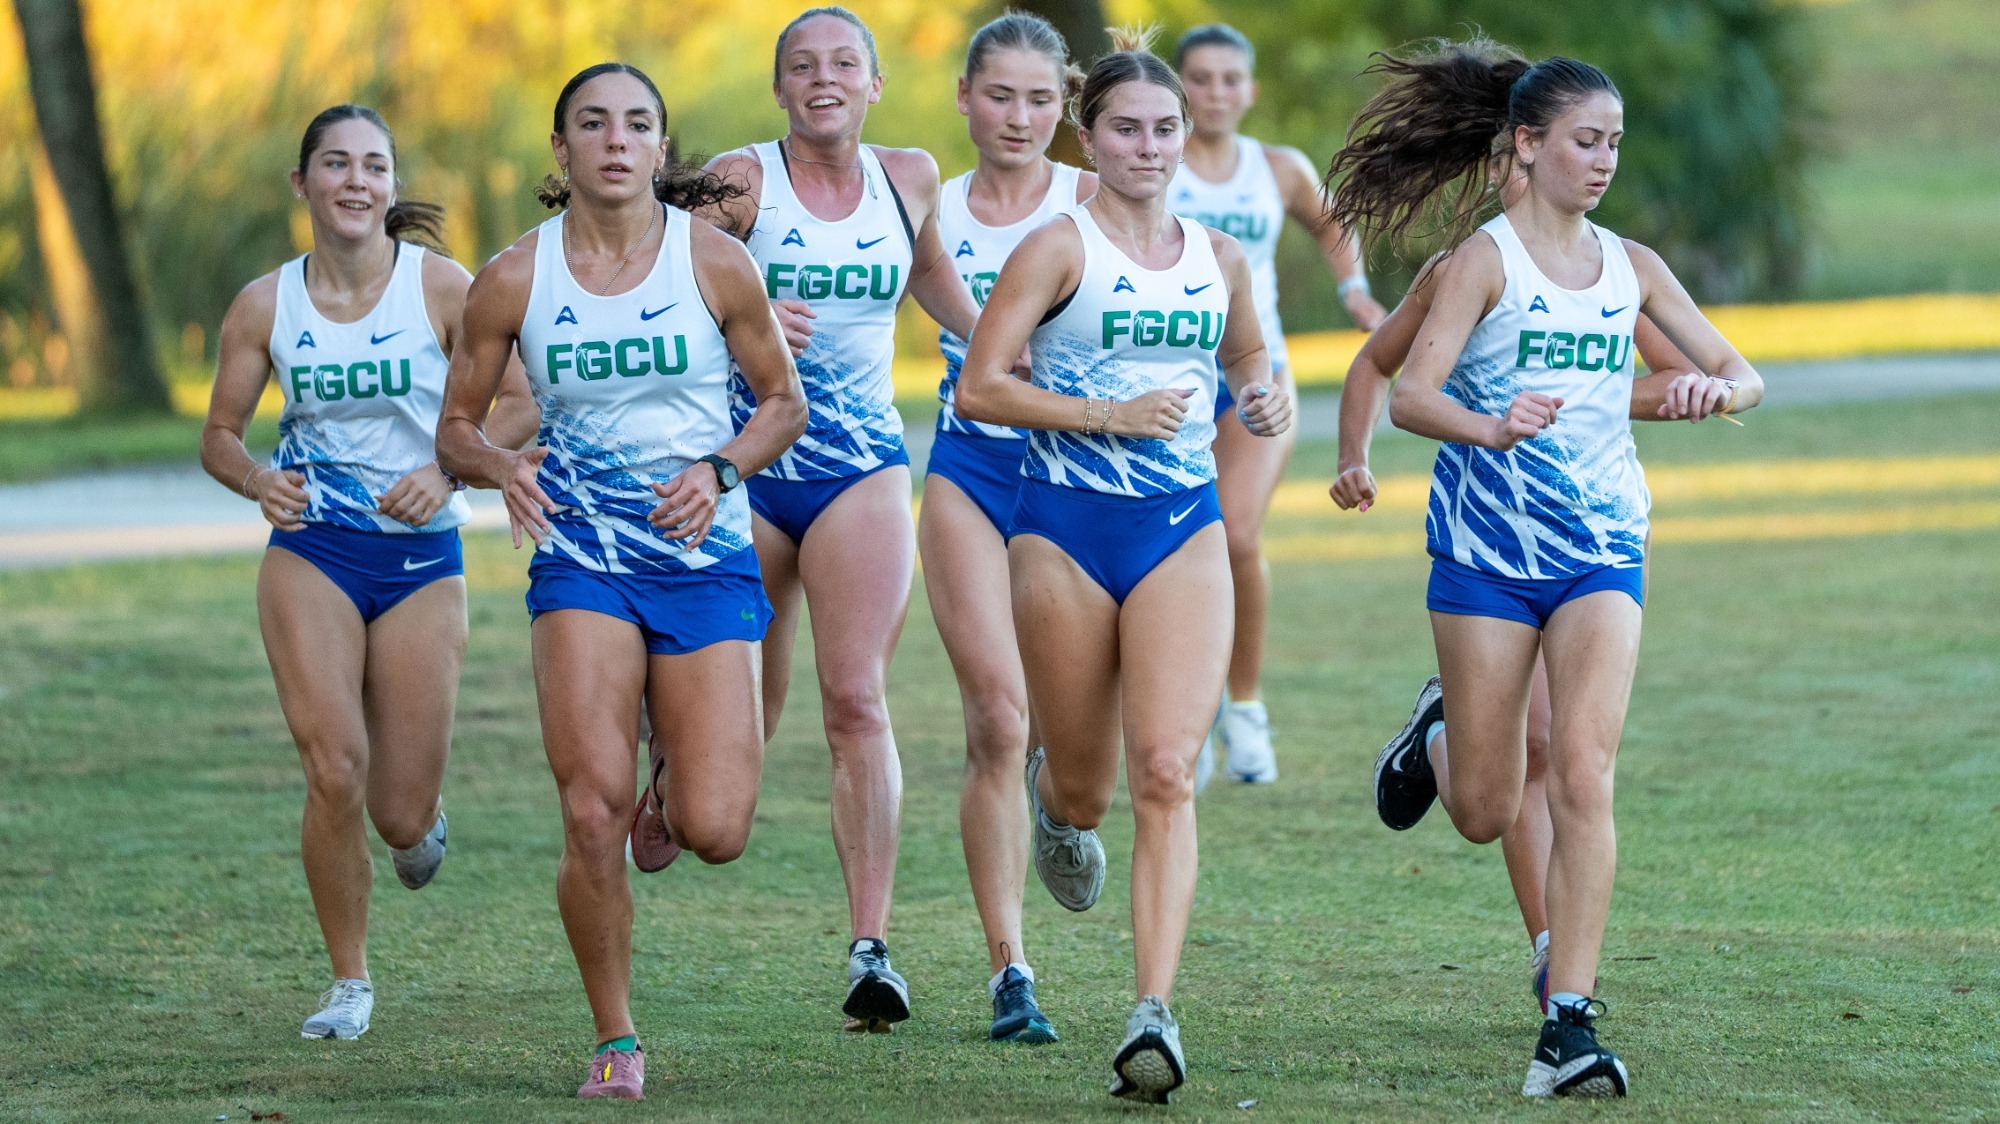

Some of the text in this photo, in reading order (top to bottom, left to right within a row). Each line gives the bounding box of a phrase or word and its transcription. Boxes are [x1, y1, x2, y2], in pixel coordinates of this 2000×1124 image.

[767, 263, 898, 300] FGCU
[1102, 310, 1223, 350] FGCU
[1515, 330, 1631, 373] FGCU
[290, 358, 411, 403] FGCU
[547, 334, 688, 384] FGCU
